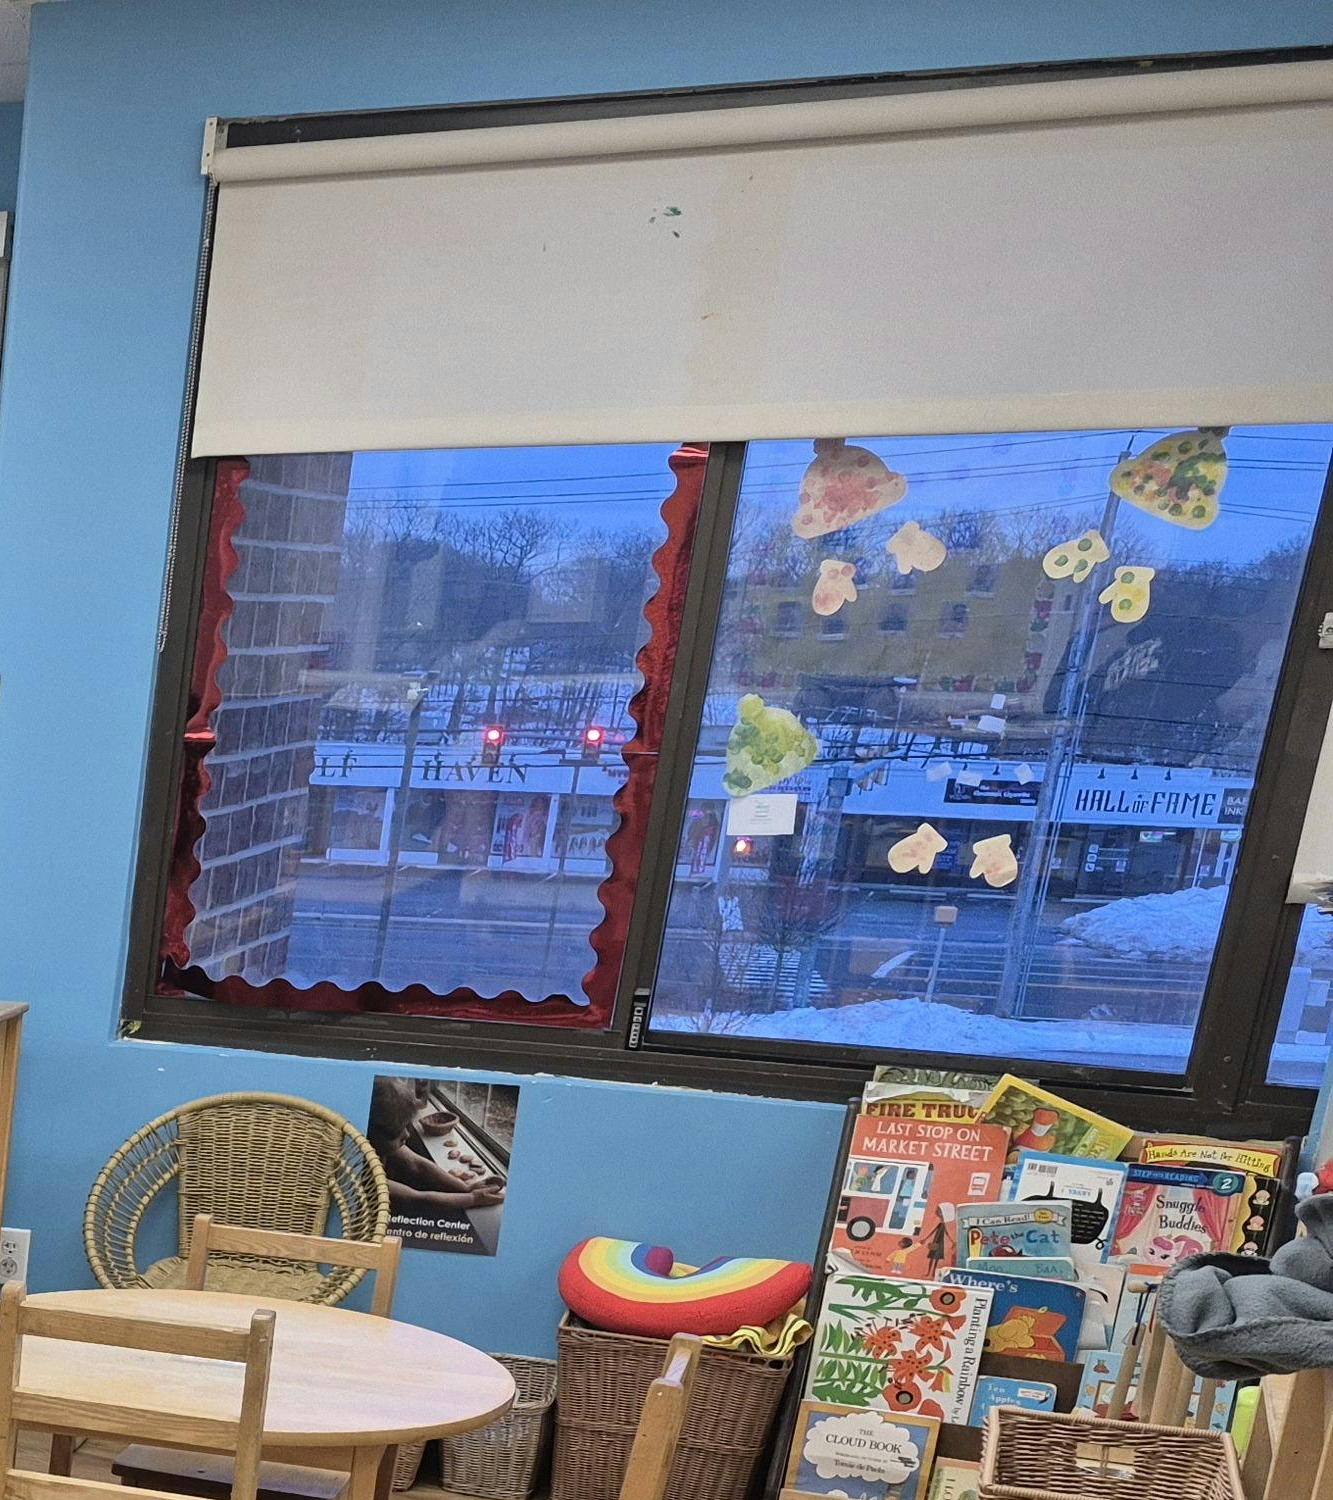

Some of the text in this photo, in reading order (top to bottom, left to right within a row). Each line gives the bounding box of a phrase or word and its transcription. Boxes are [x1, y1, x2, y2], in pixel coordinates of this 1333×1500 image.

[422, 757, 529, 784] HAVEN
[1075, 789, 1217, 818] HALL OF FAME
[866, 1103, 978, 1119] FIRE TRUC
[877, 1121, 981, 1142] LAST STOP ON
[862, 1137, 993, 1162] MARKET STREET
[1147, 1149, 1178, 1160] Hands
[1200, 1151, 1217, 1160] Not
[1235, 1153, 1272, 1173] Hitting
[1220, 1178, 1232, 1190] 2
[1156, 1194, 1206, 1215] Snuggle
[437, 1219, 470, 1230] Center
[982, 1217, 1002, 1225] Can
[1158, 1215, 1208, 1234] Buddies
[387, 1228, 474, 1243] entro de reflexión
[970, 1229, 1011, 1246] Pete
[1026, 1229, 1061, 1244] Cat
[949, 1273, 1020, 1293] Where's
[965, 1298, 988, 1346] Planting
[956, 1356, 976, 1405] Rainbow
[859, 1429, 874, 1437] THE
[826, 1434, 902, 1454] CLOUD BOOK
